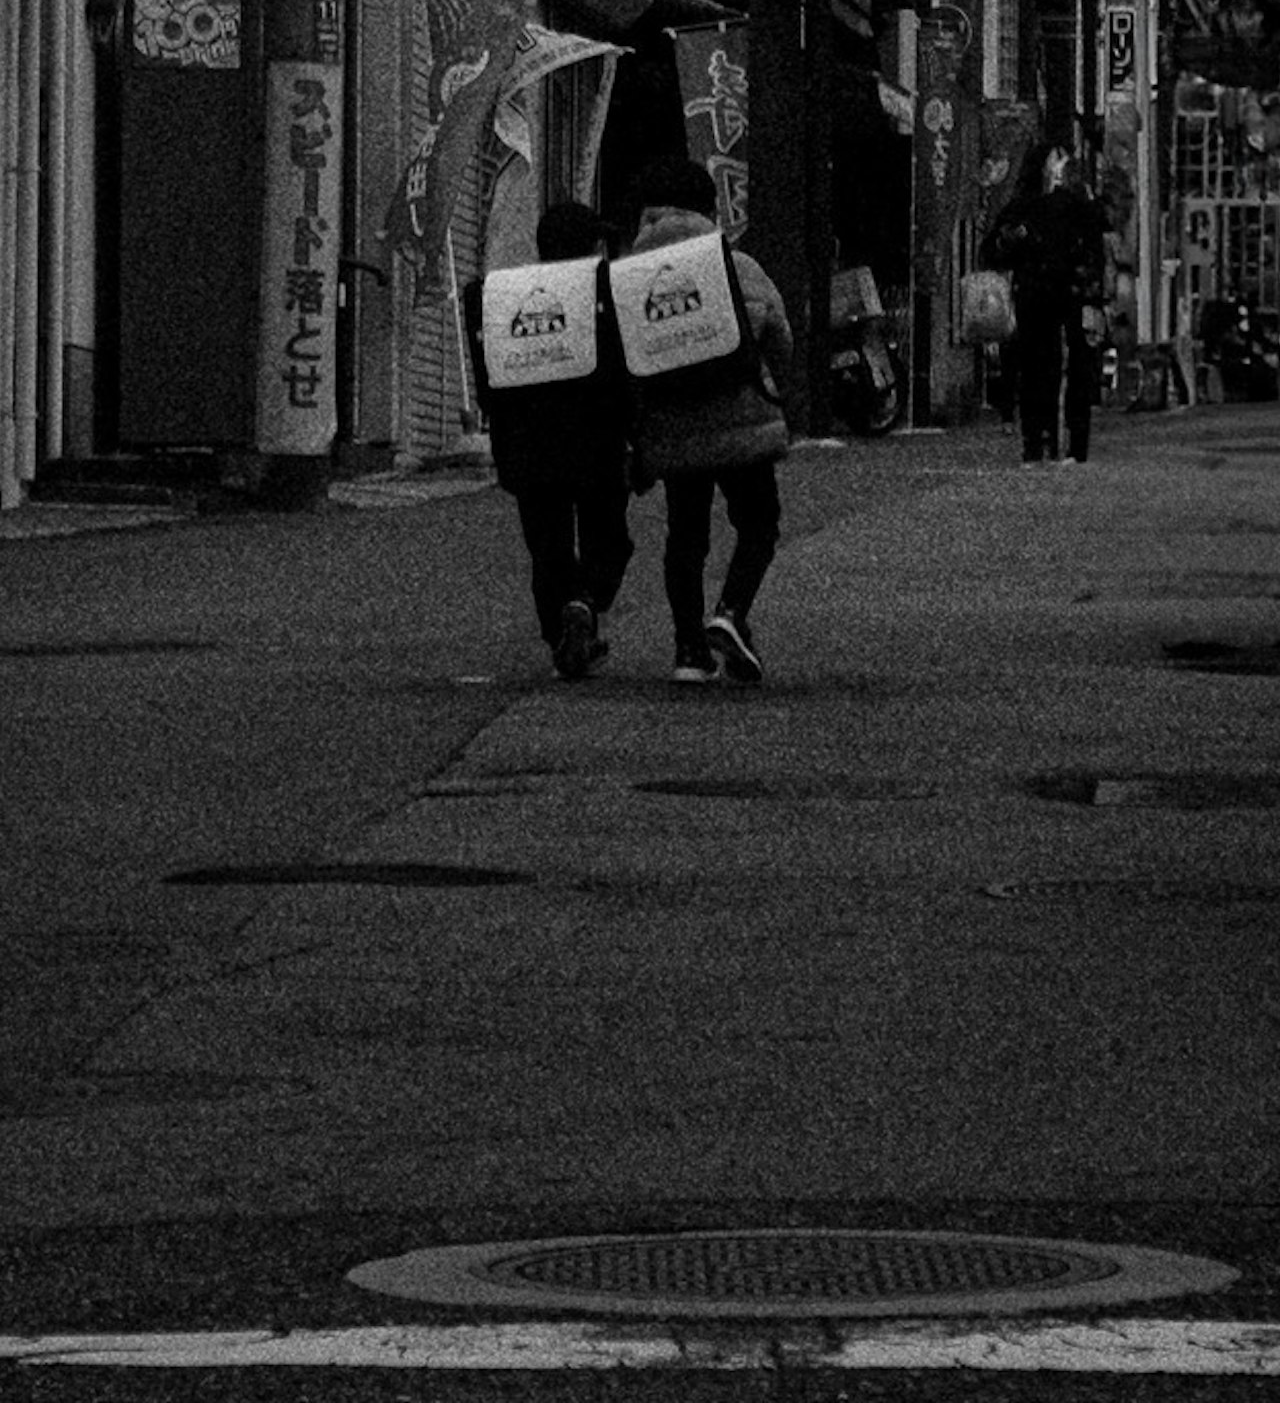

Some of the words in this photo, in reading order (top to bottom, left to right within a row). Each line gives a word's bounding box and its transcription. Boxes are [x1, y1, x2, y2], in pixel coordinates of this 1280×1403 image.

[282, 78, 331, 409] スピード落とせ
